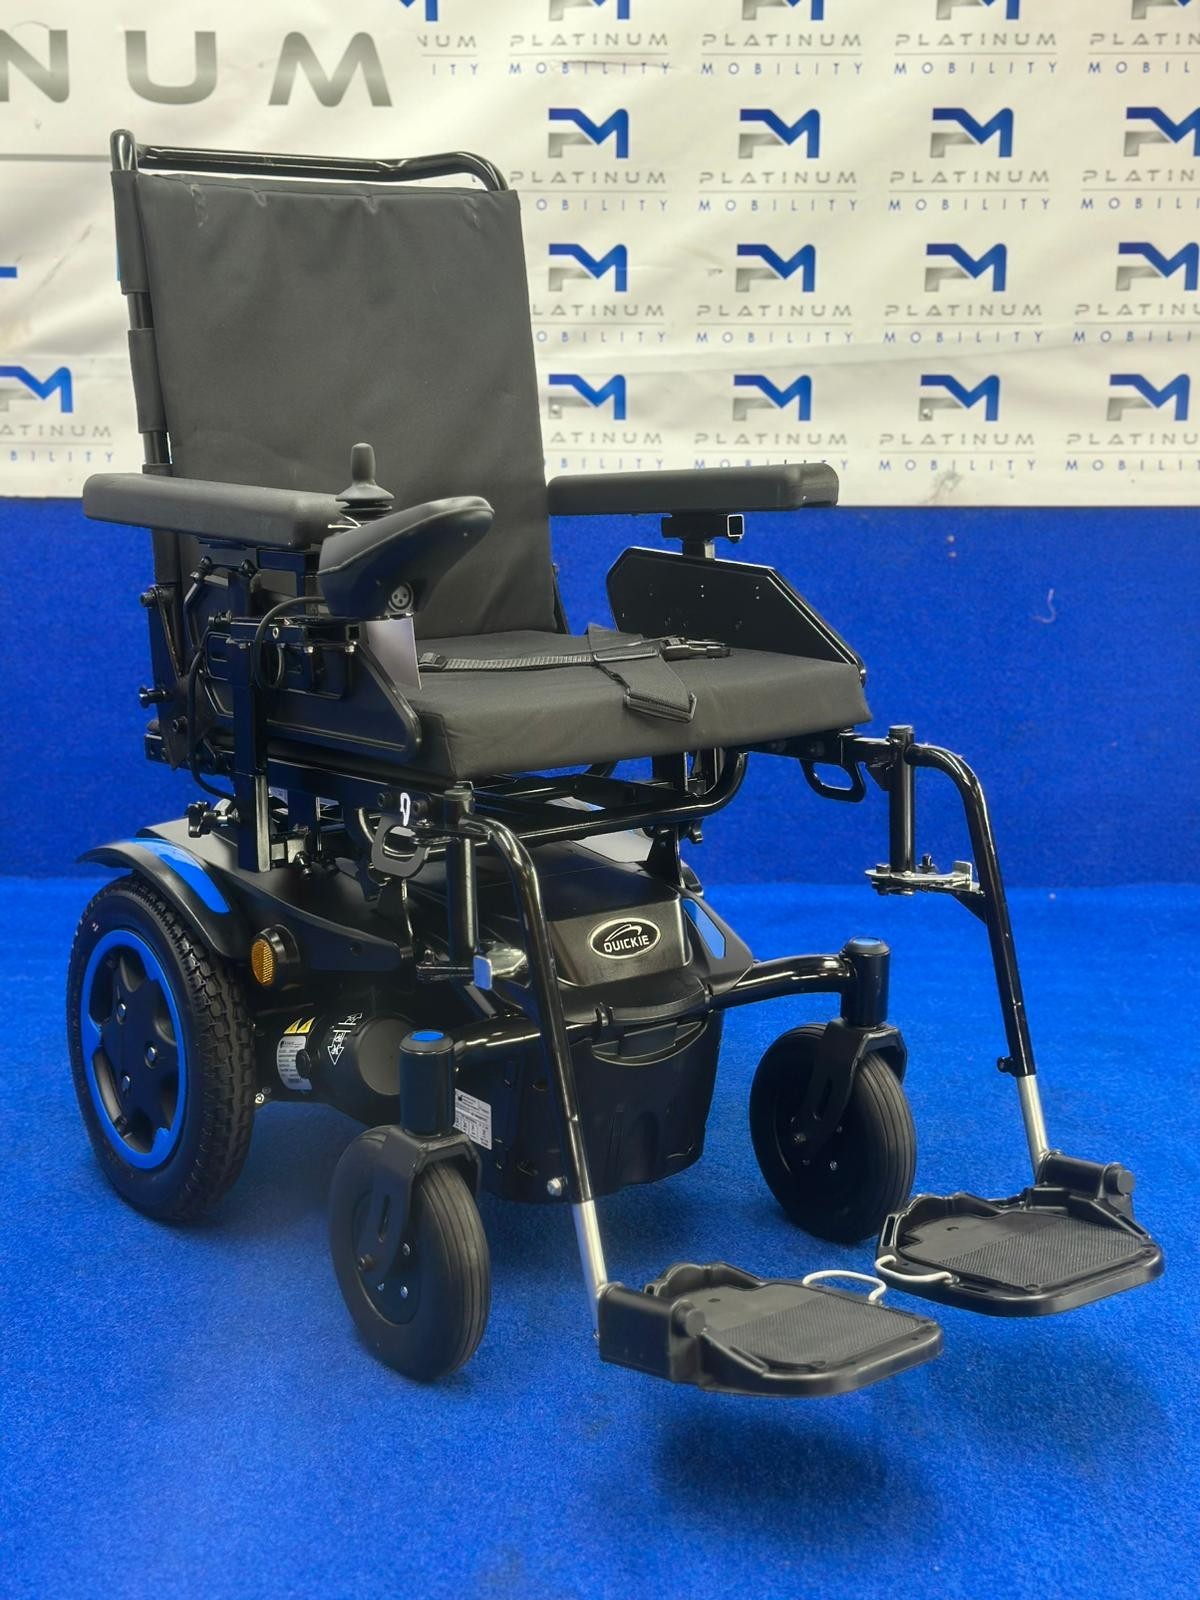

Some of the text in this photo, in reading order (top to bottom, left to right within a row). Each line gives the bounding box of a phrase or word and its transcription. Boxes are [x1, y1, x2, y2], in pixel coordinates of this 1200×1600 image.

[510, 33, 669, 47] PLATINUM
[702, 33, 862, 47] PLATINUM
[895, 33, 1057, 46] PLATINUM
[0, 29, 393, 107] NUM
[508, 62, 671, 75] MOBILITY
[701, 62, 863, 75] MOBILITY
[894, 62, 1058, 74] MOBILITY
[1088, 61, 1190, 74] MOBIL
[510, 171, 667, 184] PLATINUM
[699, 171, 857, 184] PLATINUM
[890, 171, 1050, 183] PLATINUM
[1082, 169, 1195, 182] PLATIN
[536, 199, 668, 211] OBILITY
[698, 199, 858, 211] MOBILITY
[888, 199, 1051, 211] MOBILITY
[533, 304, 664, 316] LATINUM
[696, 304, 853, 317] PLATINUM
[884, 304, 1043, 317] PLATINUM
[536, 331, 666, 343] OBILITY
[696, 331, 854, 343] MOBILITY
[884, 331, 1043, 343] MOBILITY
[1073, 331, 1192, 342] MOBILI
[551, 432, 662, 444] ATINUM
[694, 433, 848, 445] PLATINUM
[879, 433, 1035, 445] PLATINUM
[1066, 432, 1199, 445] PLATINU
[561, 458, 664, 469] BILITY
[879, 460, 1036, 471] MOBILITY
[603, 935, 650, 953] QUICKIE
